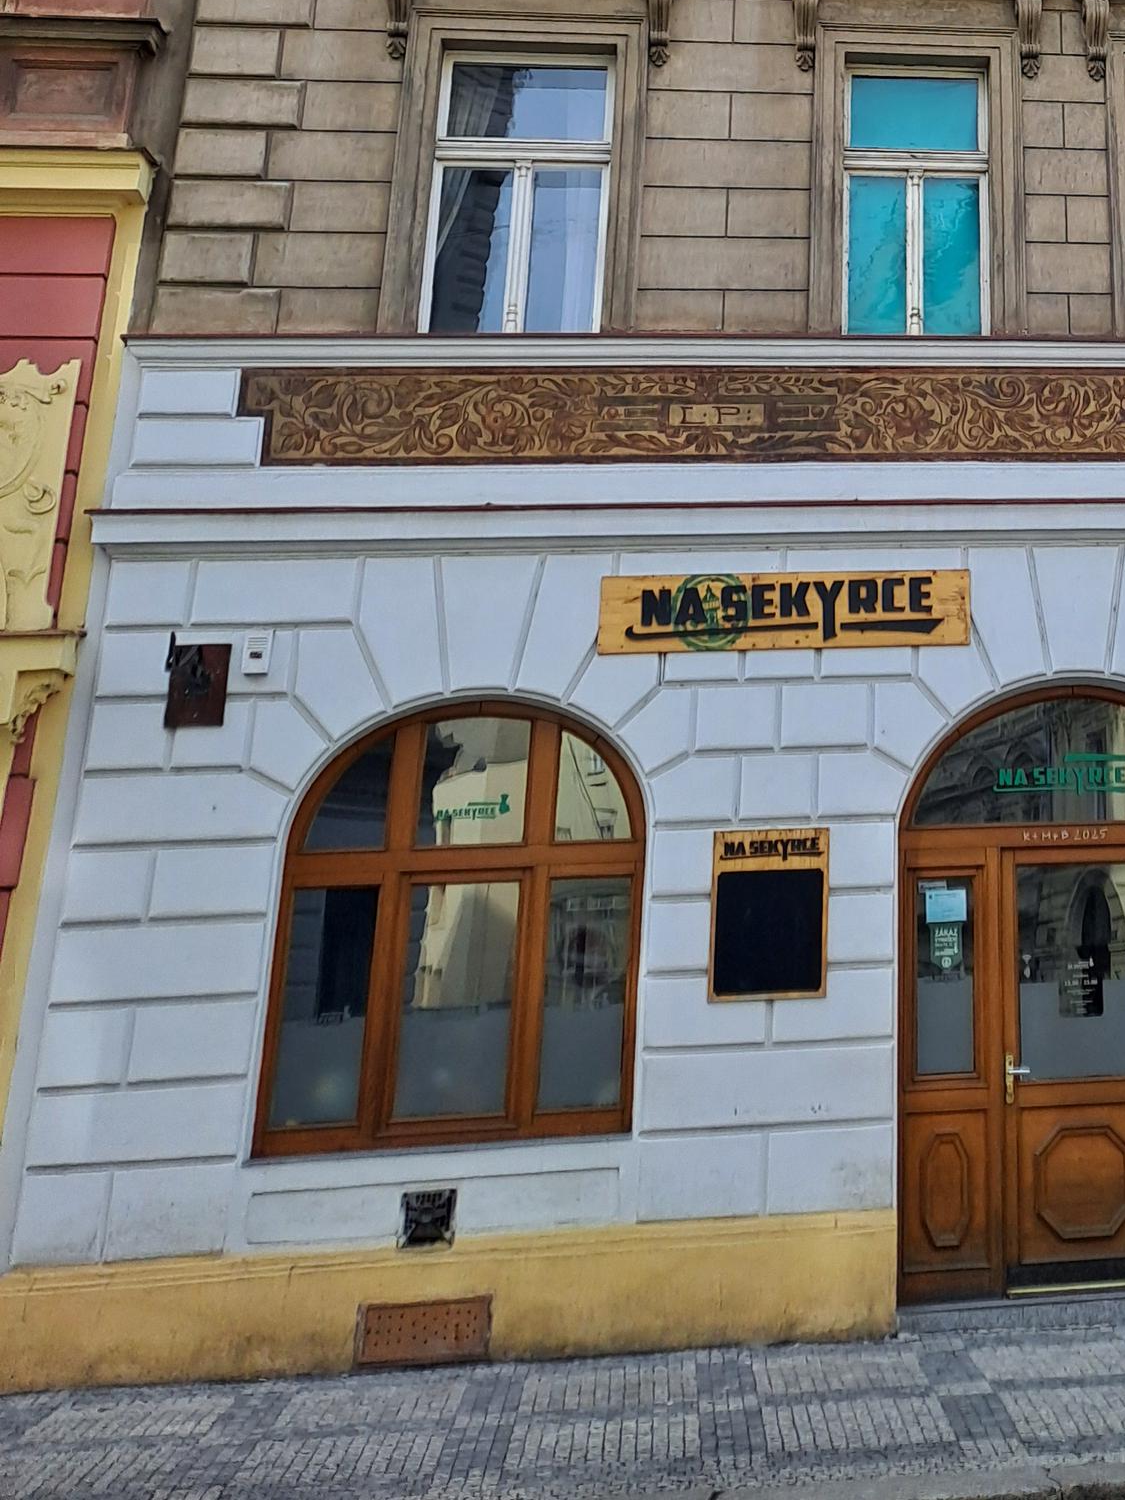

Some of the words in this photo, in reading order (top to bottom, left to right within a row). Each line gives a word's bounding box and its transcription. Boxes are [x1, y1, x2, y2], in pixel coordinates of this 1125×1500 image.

[641, 587, 707, 627] NA
[721, 576, 933, 643] SEKYRCE
[999, 766, 1029, 788] NA
[724, 841, 747, 857] NA
[749, 836, 820, 862] SEKYRCE
